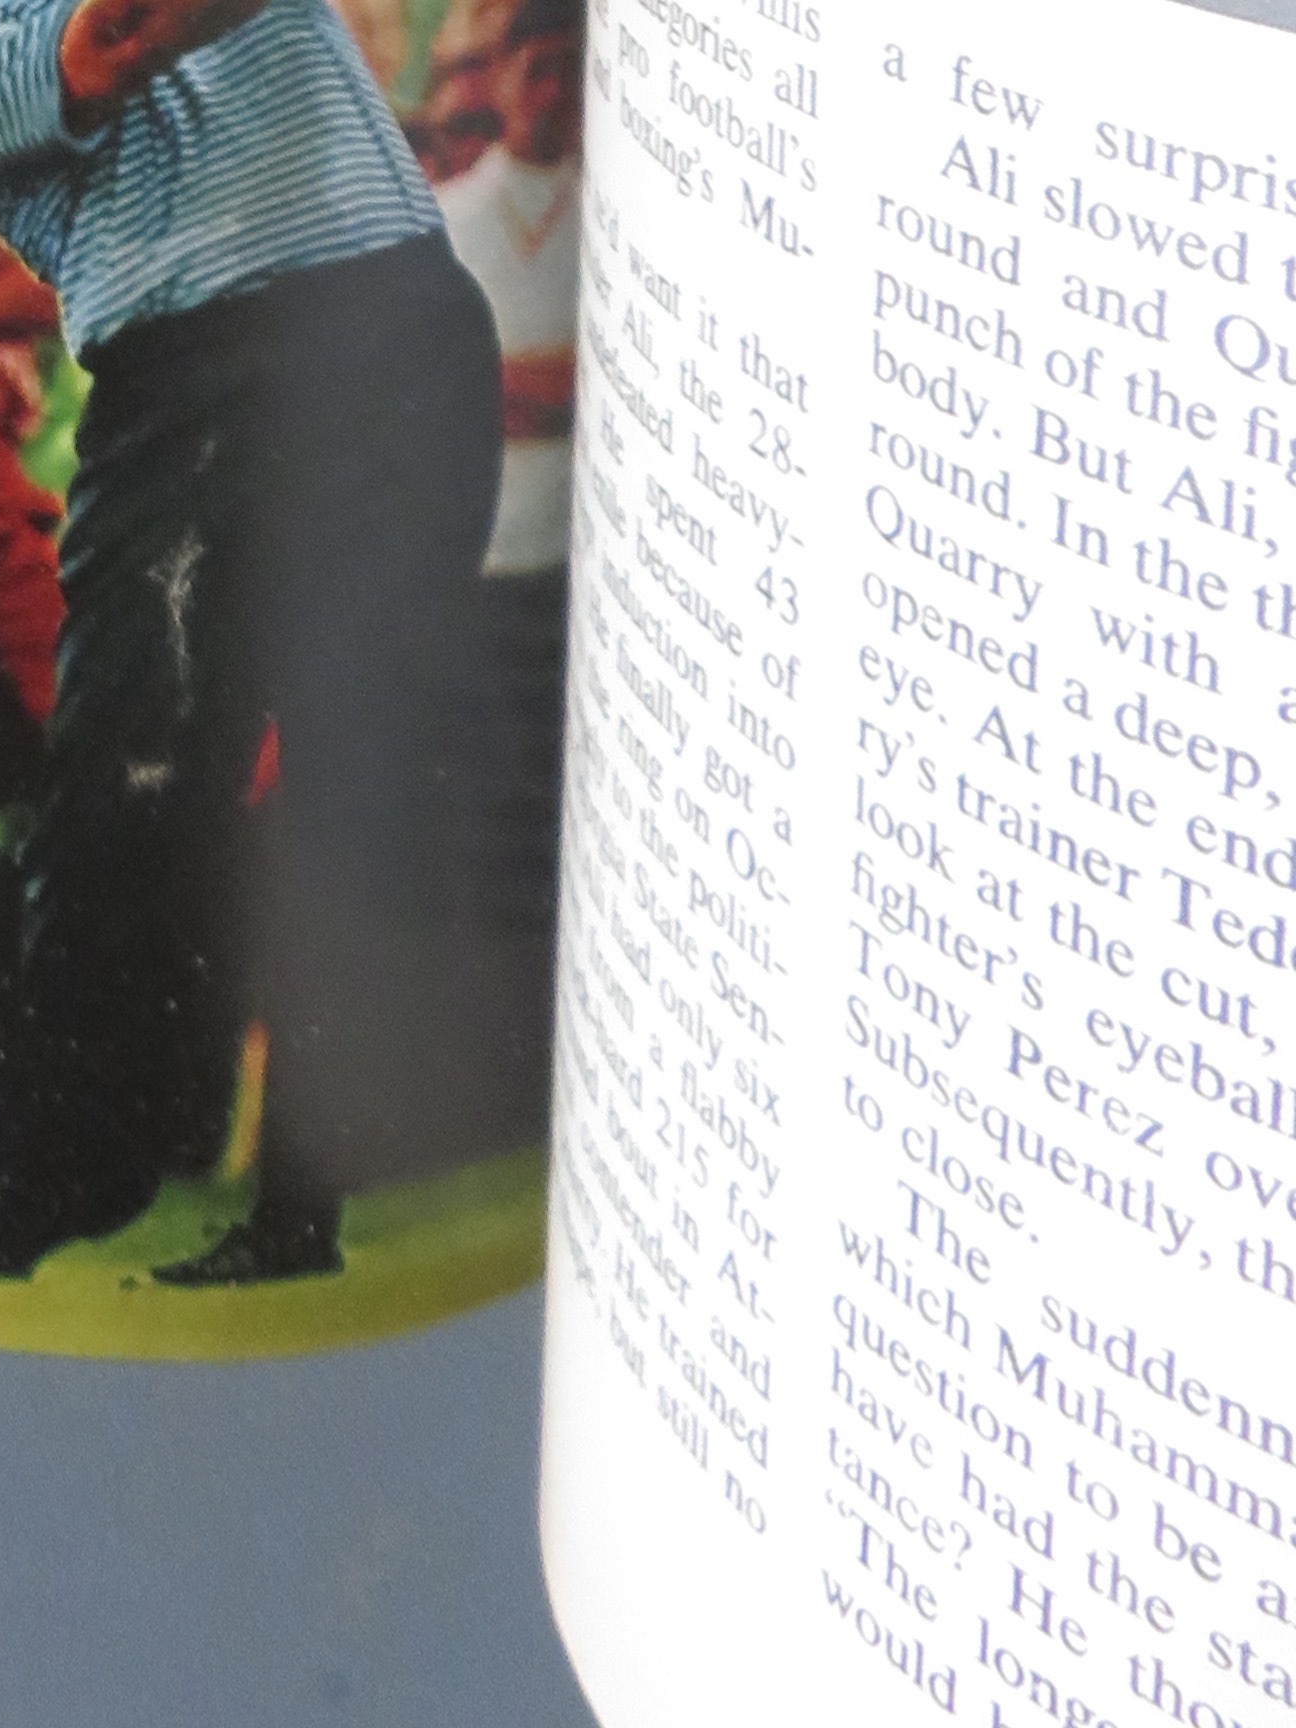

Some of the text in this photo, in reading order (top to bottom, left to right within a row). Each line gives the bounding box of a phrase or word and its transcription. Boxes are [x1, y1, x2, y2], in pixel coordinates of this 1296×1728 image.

[881, 42, 1042, 131] a few
[876, 193, 1168, 342] round and
[939, 134, 1249, 285] Ali slowed
[872, 328, 1278, 558] body. But Ali,
[873, 268, 1217, 441] punch of the
[864, 483, 1220, 694] Quarry with
[869, 421, 1228, 612] round. In the
[858, 644, 1296, 891] eye. At the end
[861, 572, 1281, 809] opened a deep,
[855, 774, 1276, 1055] look at the cut,
[955, 772, 1141, 901] trainer
[845, 993, 1211, 1269] Subsequently,
[849, 919, 1164, 1157] Tony Perez
[896, 1179, 990, 1285] The
[900, 1126, 1039, 1243] close.
[838, 1220, 970, 1351] which
[830, 1346, 1175, 1634] have had the
[832, 1293, 1221, 1583] question to be
[822, 1569, 957, 1715] would
[827, 1426, 1086, 1657] tance? He
